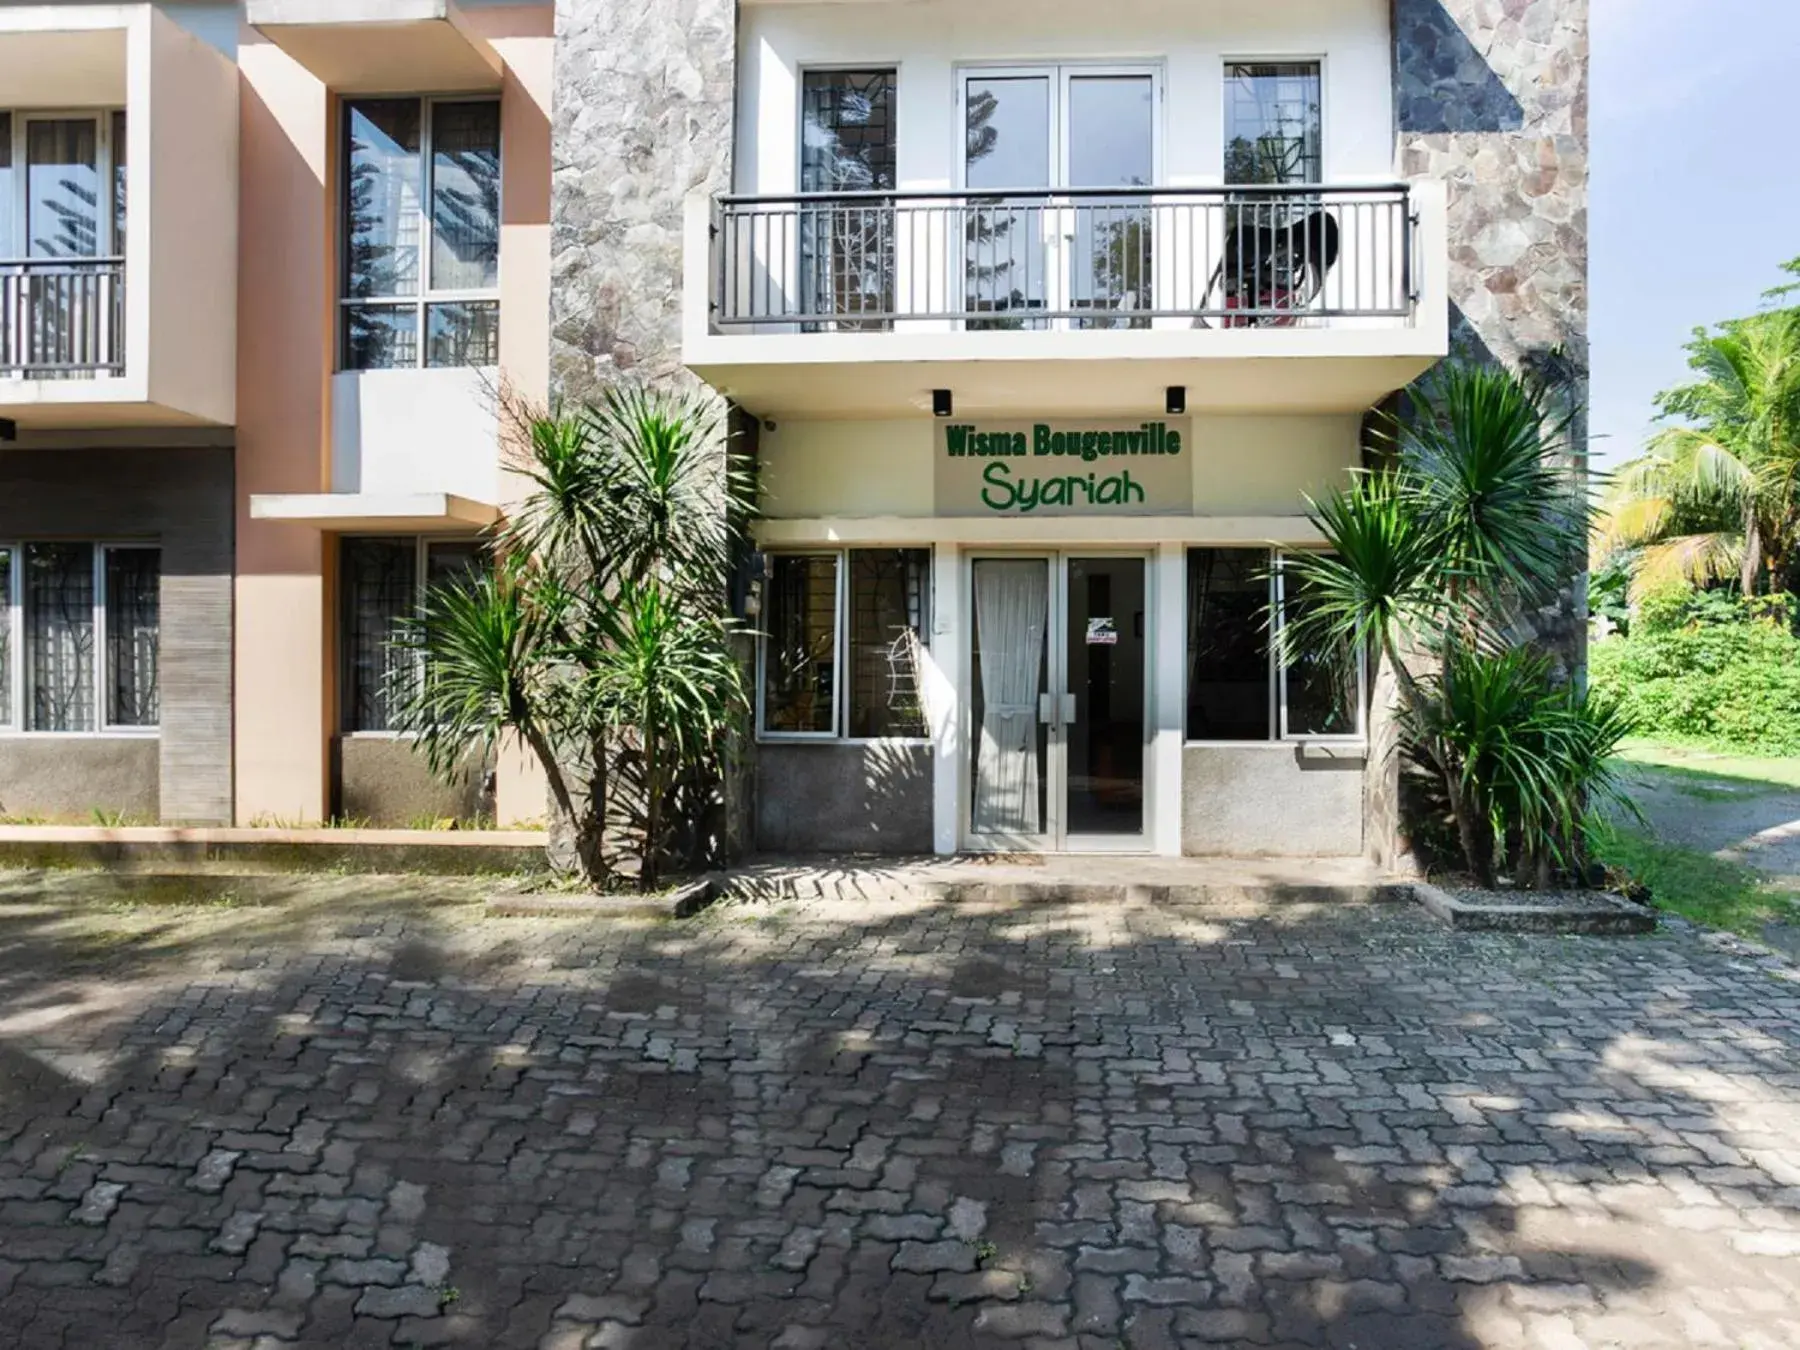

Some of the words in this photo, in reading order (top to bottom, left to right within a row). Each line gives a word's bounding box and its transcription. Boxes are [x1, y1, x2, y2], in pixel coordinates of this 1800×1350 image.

[945, 424, 1027, 457] Wisma
[1032, 422, 1181, 462] Bougenville
[980, 461, 1145, 512] Syariah
